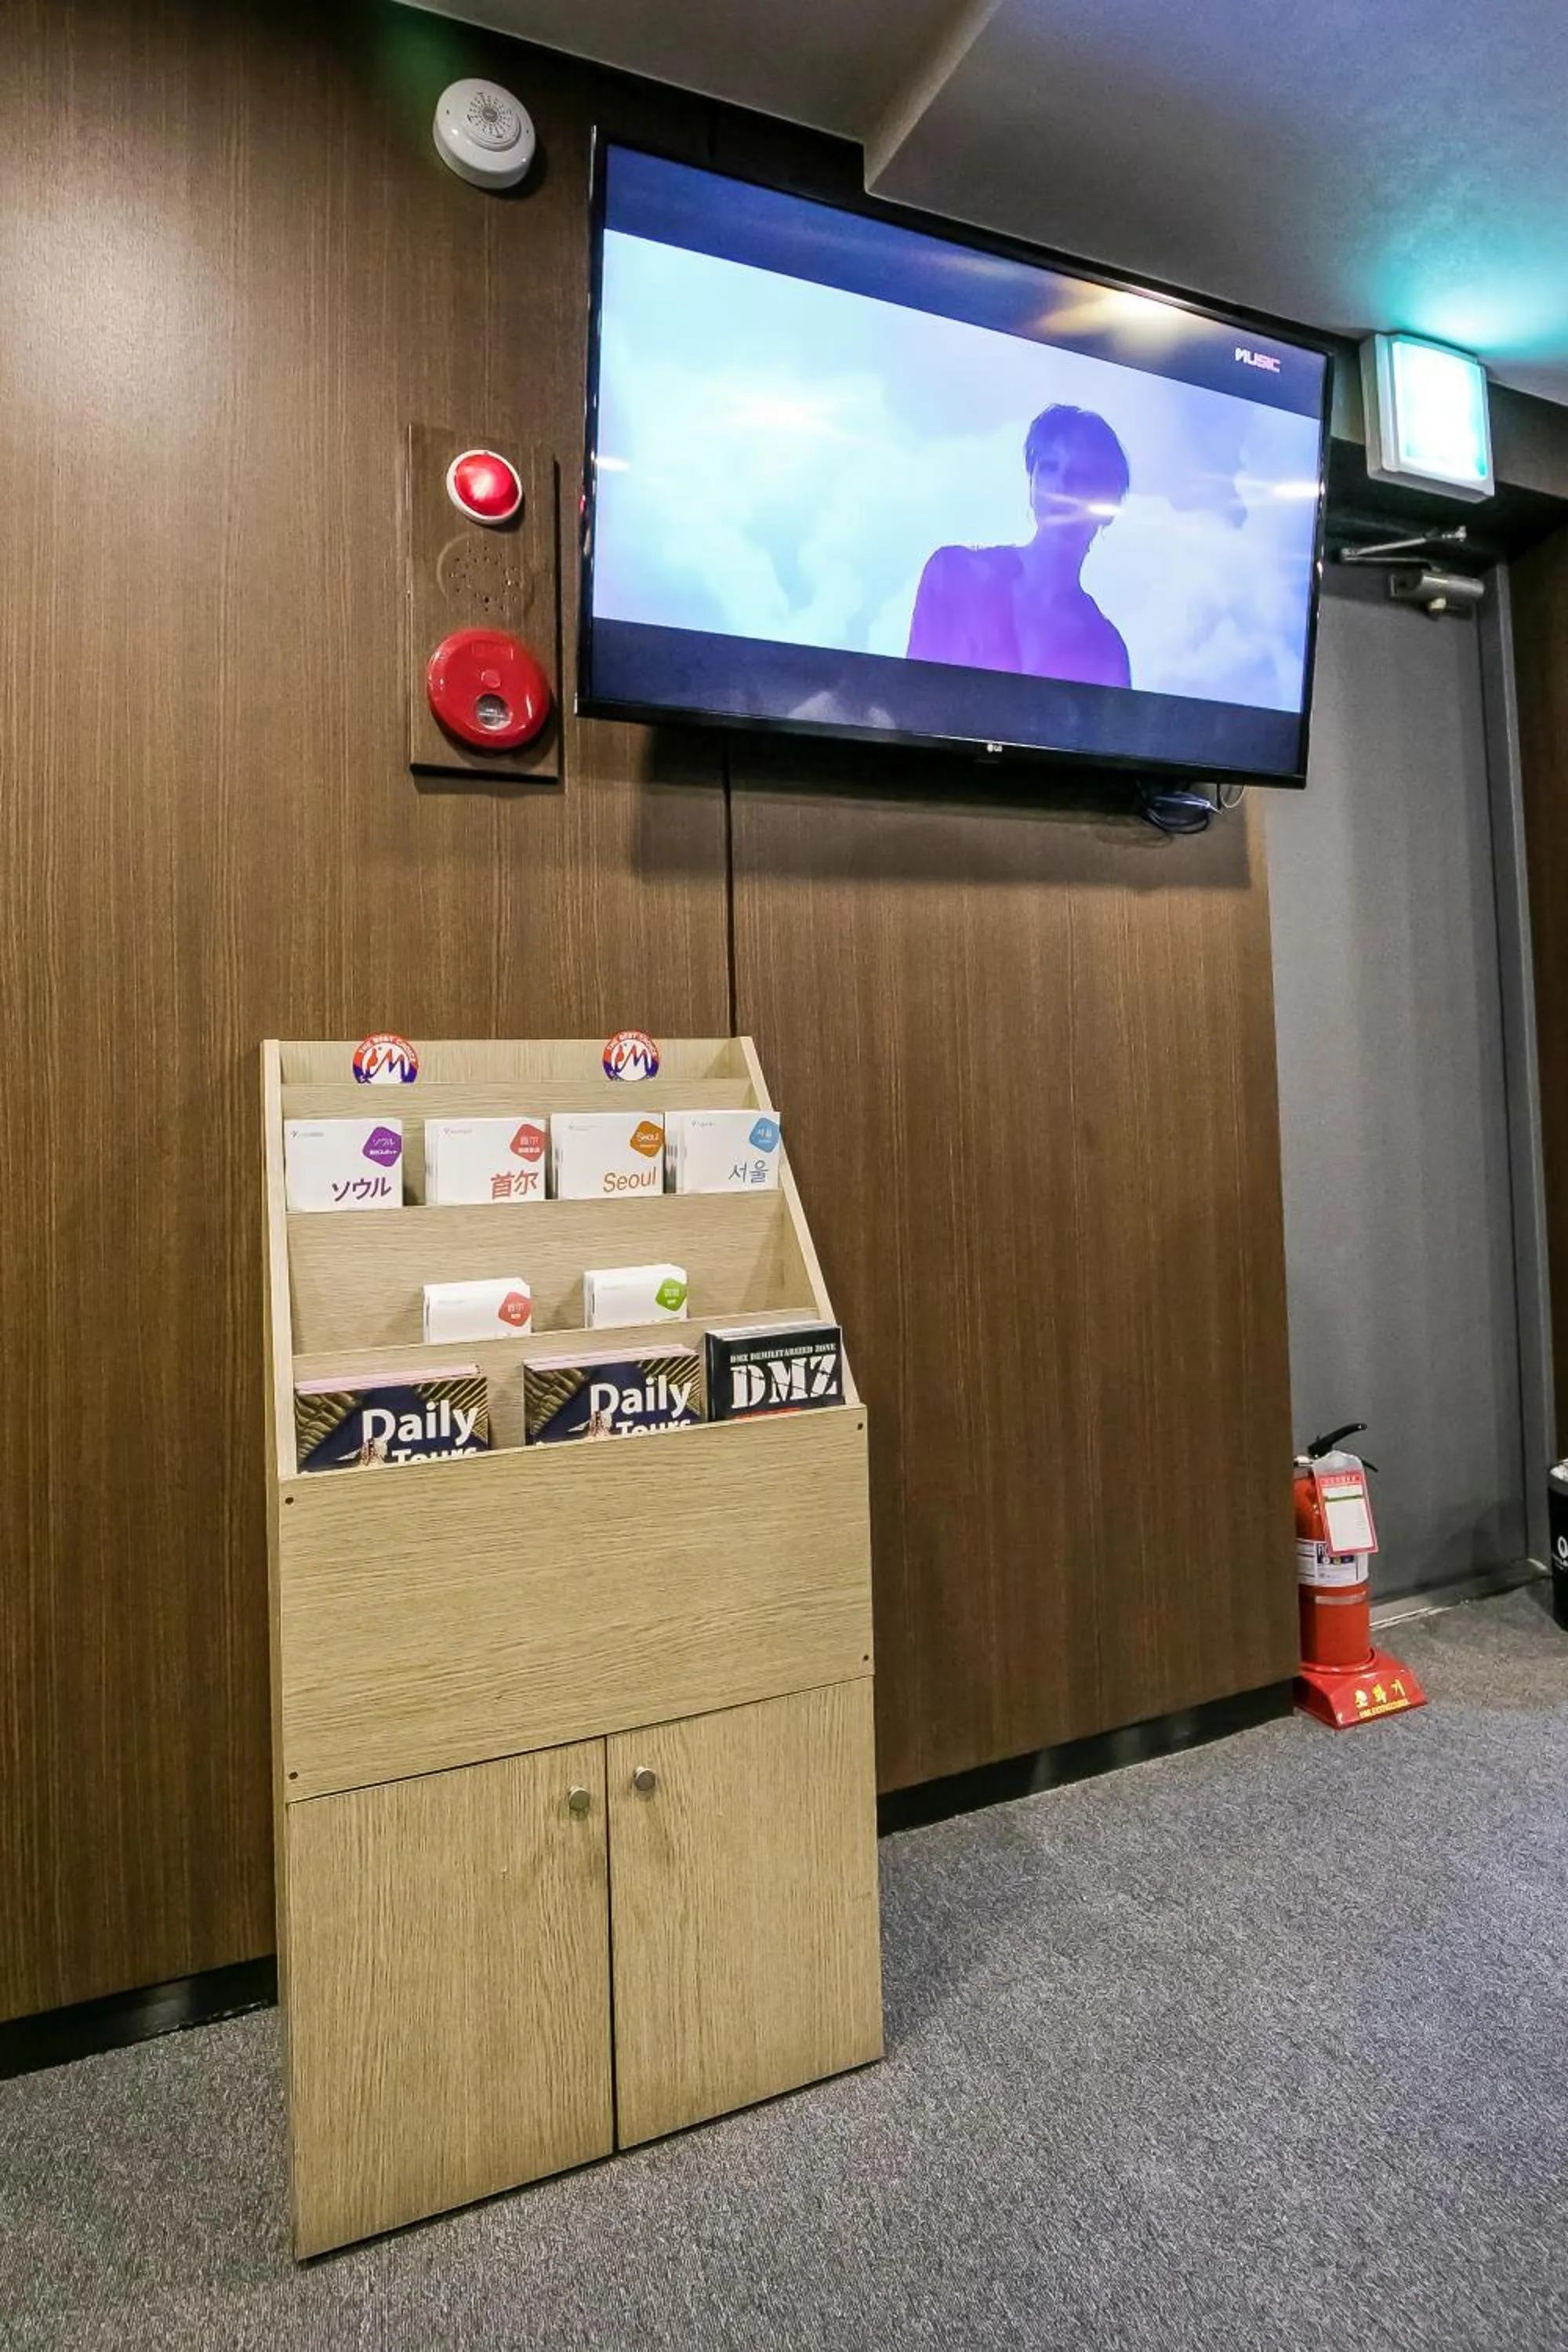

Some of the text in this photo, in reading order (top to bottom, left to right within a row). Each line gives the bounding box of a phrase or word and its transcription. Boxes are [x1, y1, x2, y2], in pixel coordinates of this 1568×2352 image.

[1235, 347, 1280, 373] MUSIC
[603, 1166, 656, 1192] Seoul
[728, 1160, 768, 1183] 서울
[332, 1177, 391, 1202] ソウル
[490, 1170, 539, 1200] 首尔
[815, 1343, 837, 1353] ZONE
[730, 1354, 837, 1409] DMZ
[590, 1374, 692, 1418] Daily
[361, 1399, 479, 1446] Daily
